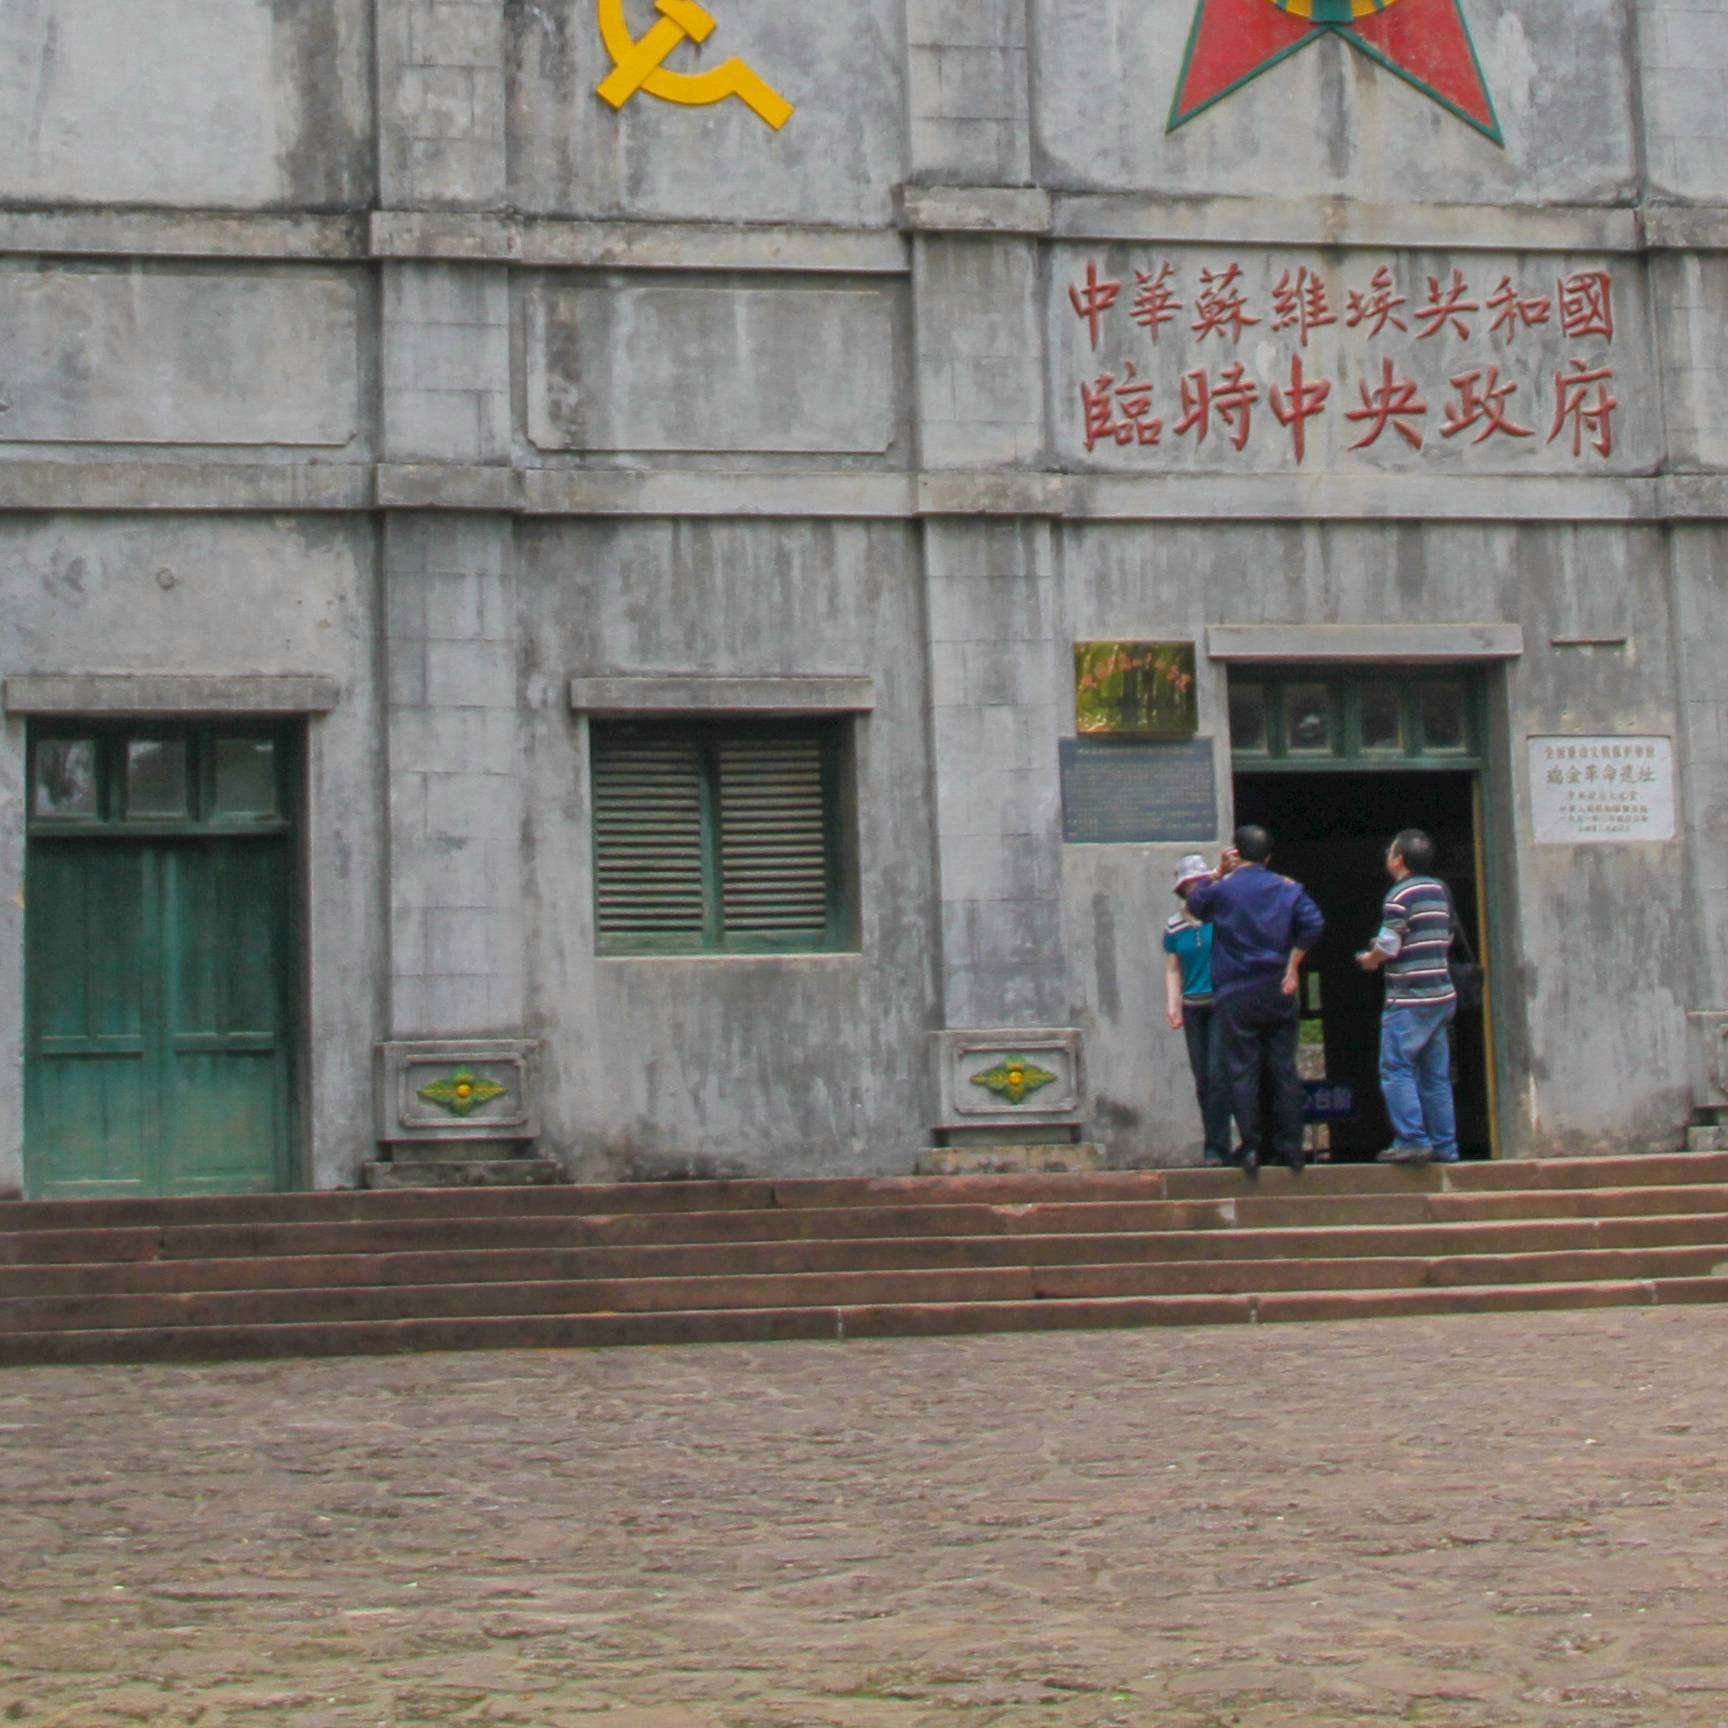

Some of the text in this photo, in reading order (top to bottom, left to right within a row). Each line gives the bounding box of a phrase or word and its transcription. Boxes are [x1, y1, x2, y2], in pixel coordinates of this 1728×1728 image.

[1068, 257, 1615, 351] 中華蘇維埃共和國
[1080, 352, 1618, 465] 臨時中央政府
